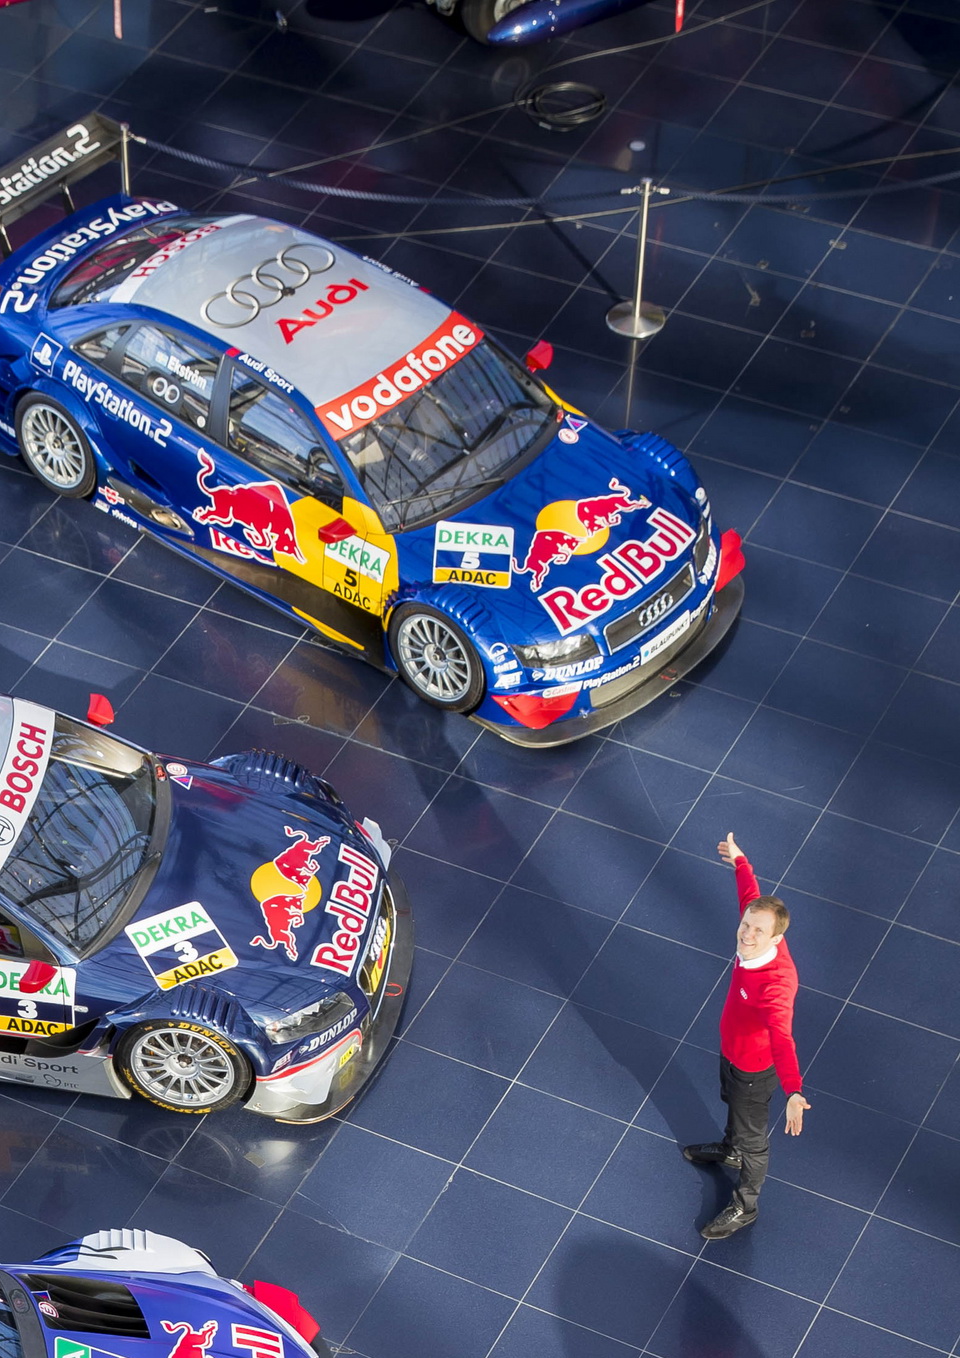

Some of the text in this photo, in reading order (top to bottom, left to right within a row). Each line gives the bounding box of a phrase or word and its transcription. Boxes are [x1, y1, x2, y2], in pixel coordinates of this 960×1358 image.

[131, 224, 222, 277] BOSCH
[275, 277, 370, 344] Audi
[167, 355, 207, 390] Ekström
[239, 353, 295, 394] Audi Sport
[326, 323, 476, 432] vodafone
[438, 528, 510, 548] DEKRA
[325, 537, 383, 577] DEKRA
[461, 551, 481, 569] 5
[540, 555, 641, 634] Red
[616, 508, 696, 583] Bull
[343, 569, 357, 586] 5
[447, 570, 497, 585] ADAC
[333, 582, 372, 611] ADAC
[650, 618, 688, 654] BLAUPUNKT
[542, 655, 604, 681] DUNLOP
[310, 843, 379, 977] Red Bull
[131, 911, 208, 948] DEKRA
[174, 941, 199, 963] 3
[174, 954, 224, 984] ADAC
[17, 1000, 38, 1019] 3
[6, 1018, 59, 1036] ADAC
[178, 1022, 236, 1056] DUNLOP
[309, 1007, 358, 1052] DUNLOP
[24, 1057, 79, 1074] Sport
